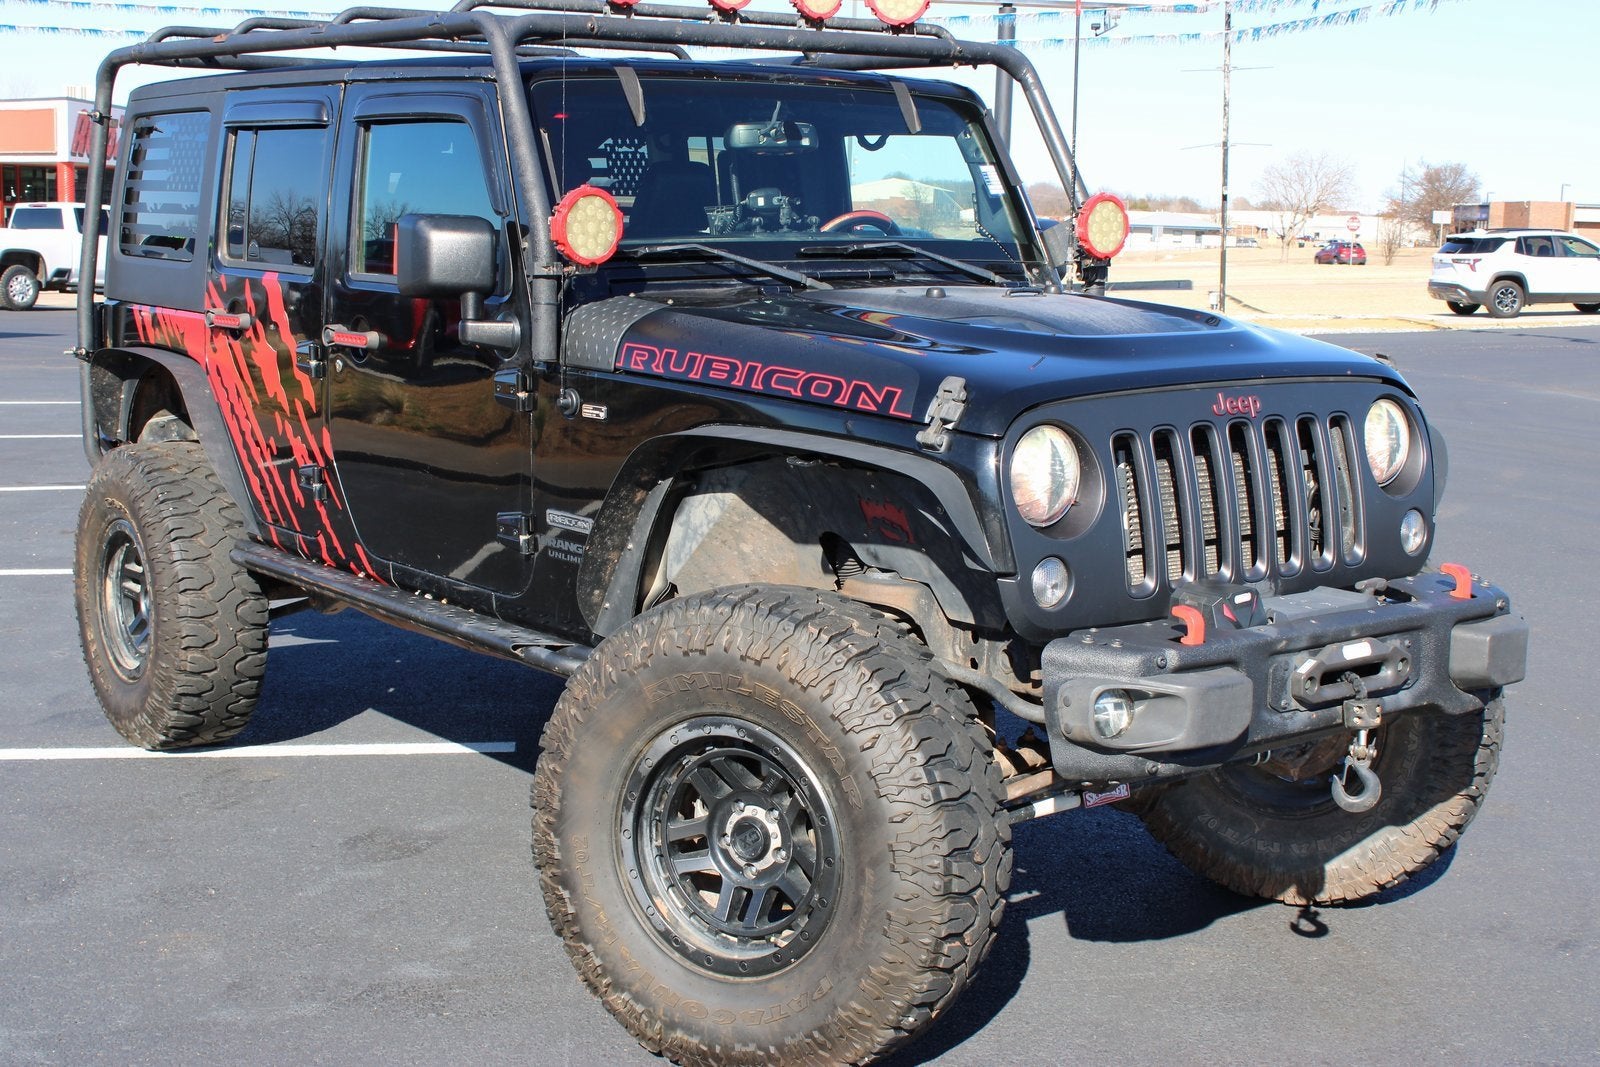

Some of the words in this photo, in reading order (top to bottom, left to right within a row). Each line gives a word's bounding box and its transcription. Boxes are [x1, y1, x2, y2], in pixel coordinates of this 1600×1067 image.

[616, 342, 912, 418] RUBICON
[1212, 392, 1261, 418] Jeep
[536, 534, 584, 556] WRANG
[548, 550, 582, 564] UNLIMI
[674, 671, 863, 811] MILESTAR
[620, 945, 834, 1026] PATAGONIA
